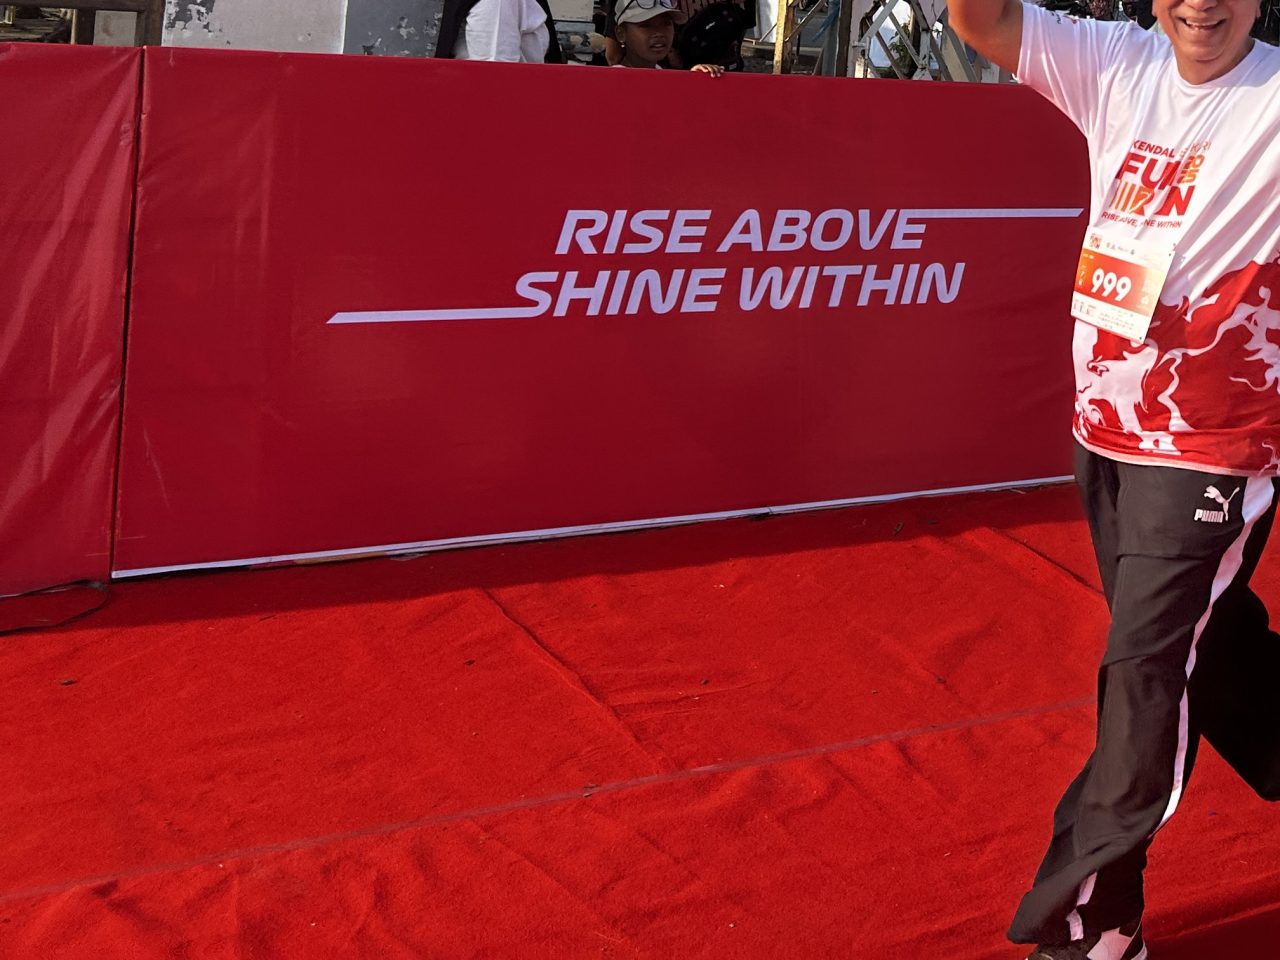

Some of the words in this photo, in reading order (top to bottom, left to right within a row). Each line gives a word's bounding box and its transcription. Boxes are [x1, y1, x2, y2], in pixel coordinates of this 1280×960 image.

[1132, 139, 1175, 158] KENDAL
[1115, 151, 1181, 191] FUN
[1127, 185, 1195, 216] RN
[555, 209, 712, 255] RISE
[717, 208, 927, 254] ABOVE
[513, 268, 726, 317] SHINE
[737, 262, 965, 312] WITHIN
[1091, 268, 1132, 302] 999
[1194, 508, 1224, 523] PUMA
